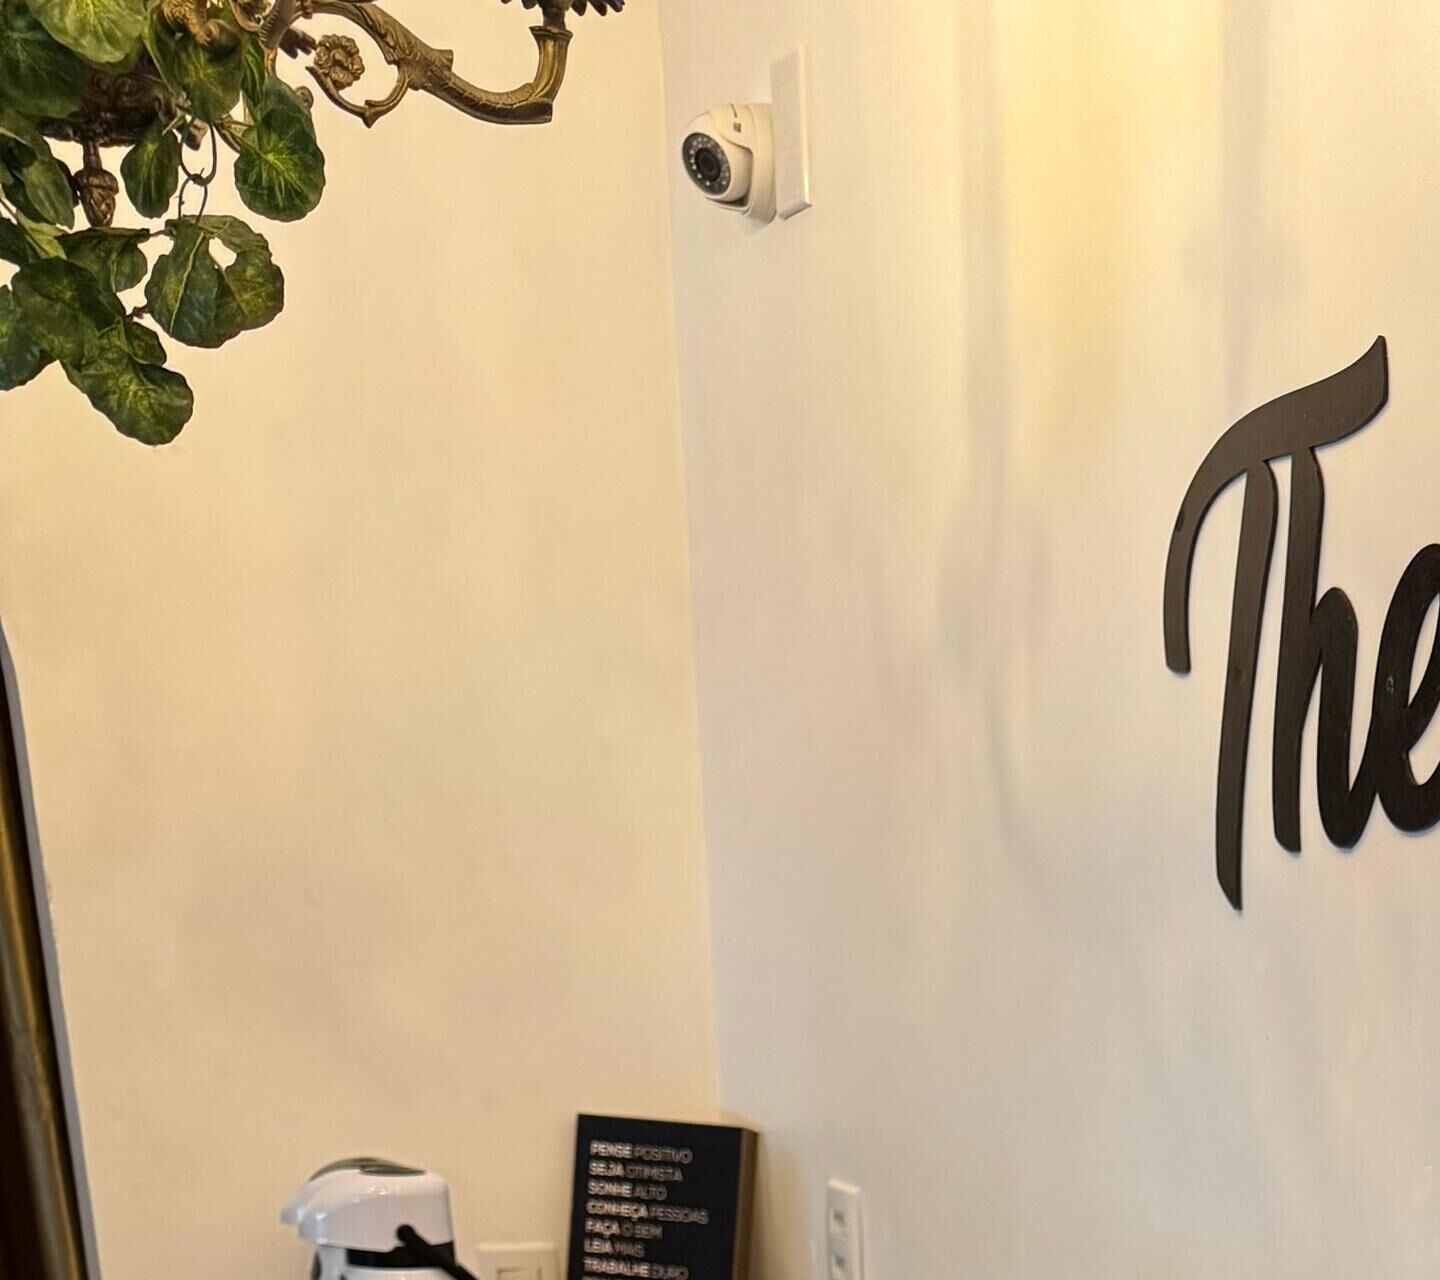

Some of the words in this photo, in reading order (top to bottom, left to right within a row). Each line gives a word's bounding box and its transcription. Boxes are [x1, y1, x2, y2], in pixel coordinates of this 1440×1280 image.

[590, 1140, 633, 1159] PENSE
[634, 1144, 693, 1164] POSITIVO
[589, 1160, 625, 1178] SEJA
[587, 1180, 633, 1198] SONHE
[634, 1184, 668, 1201] ALTO
[586, 1199, 650, 1222] CONHEÇA
[650, 1205, 709, 1225] PESSOAS
[585, 1218, 621, 1239] FAÇA
[634, 1224, 663, 1240] BEM
[584, 1237, 614, 1255] LEIA
[583, 1256, 651, 1278] TRABALHE
